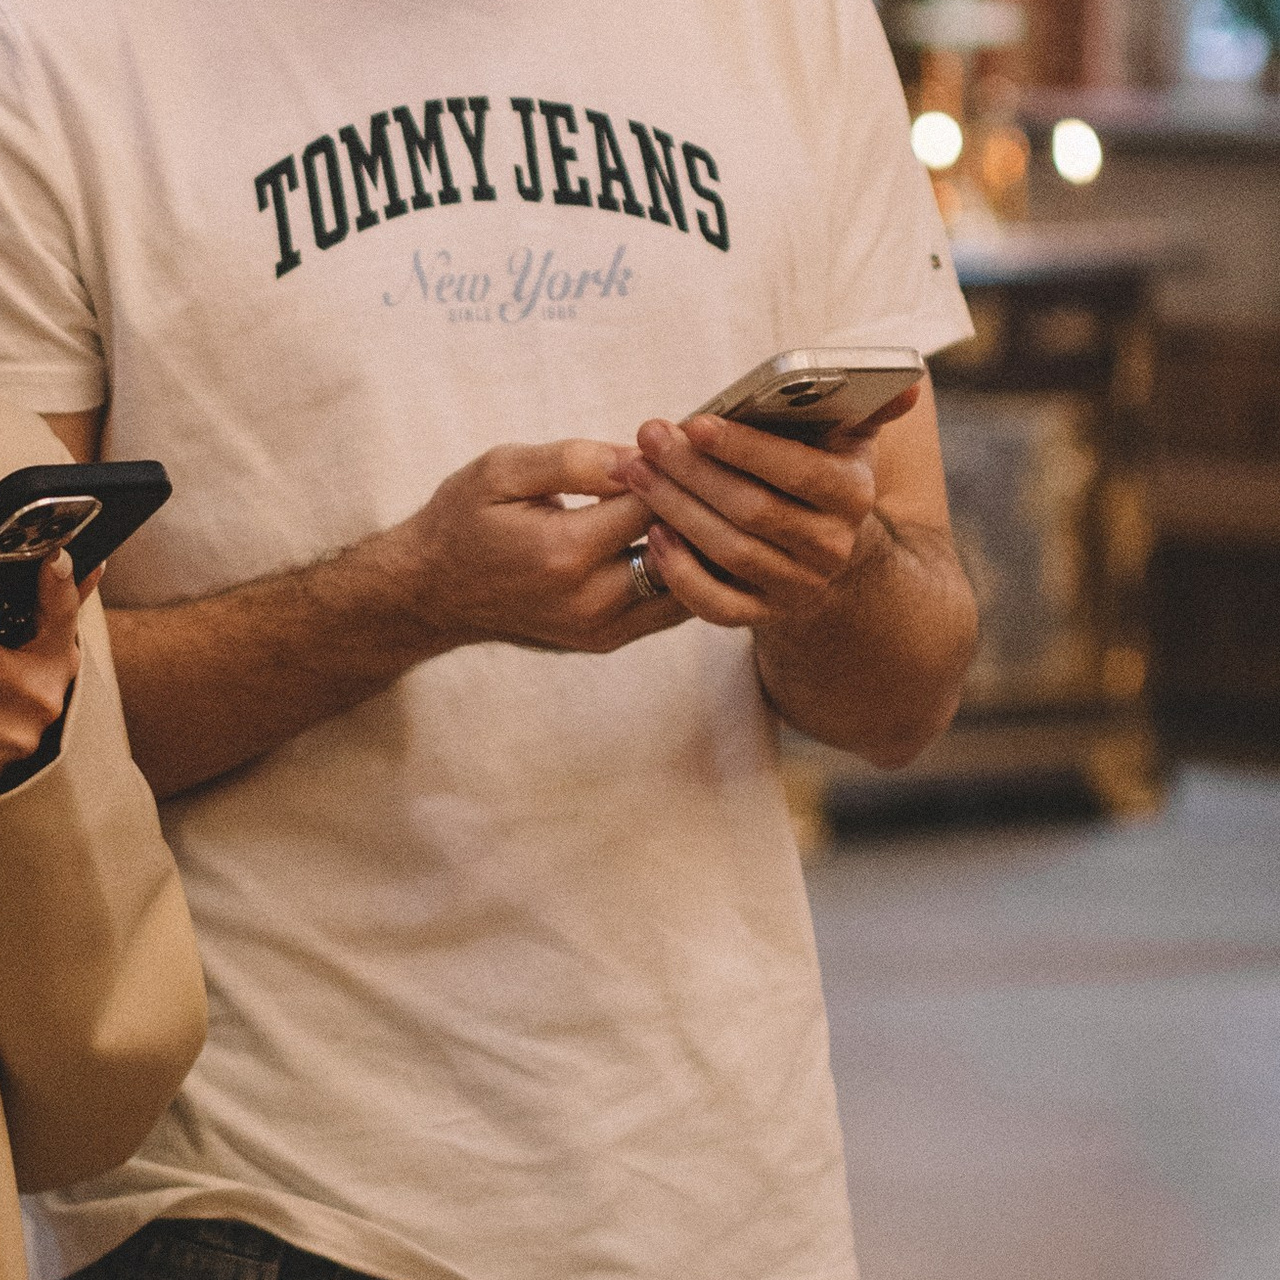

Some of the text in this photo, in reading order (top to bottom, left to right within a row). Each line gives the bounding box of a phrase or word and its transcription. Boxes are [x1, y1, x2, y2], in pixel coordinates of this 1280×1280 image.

[253, 96, 730, 279] TOMMY JEANS
[382, 244, 633, 324] New York
